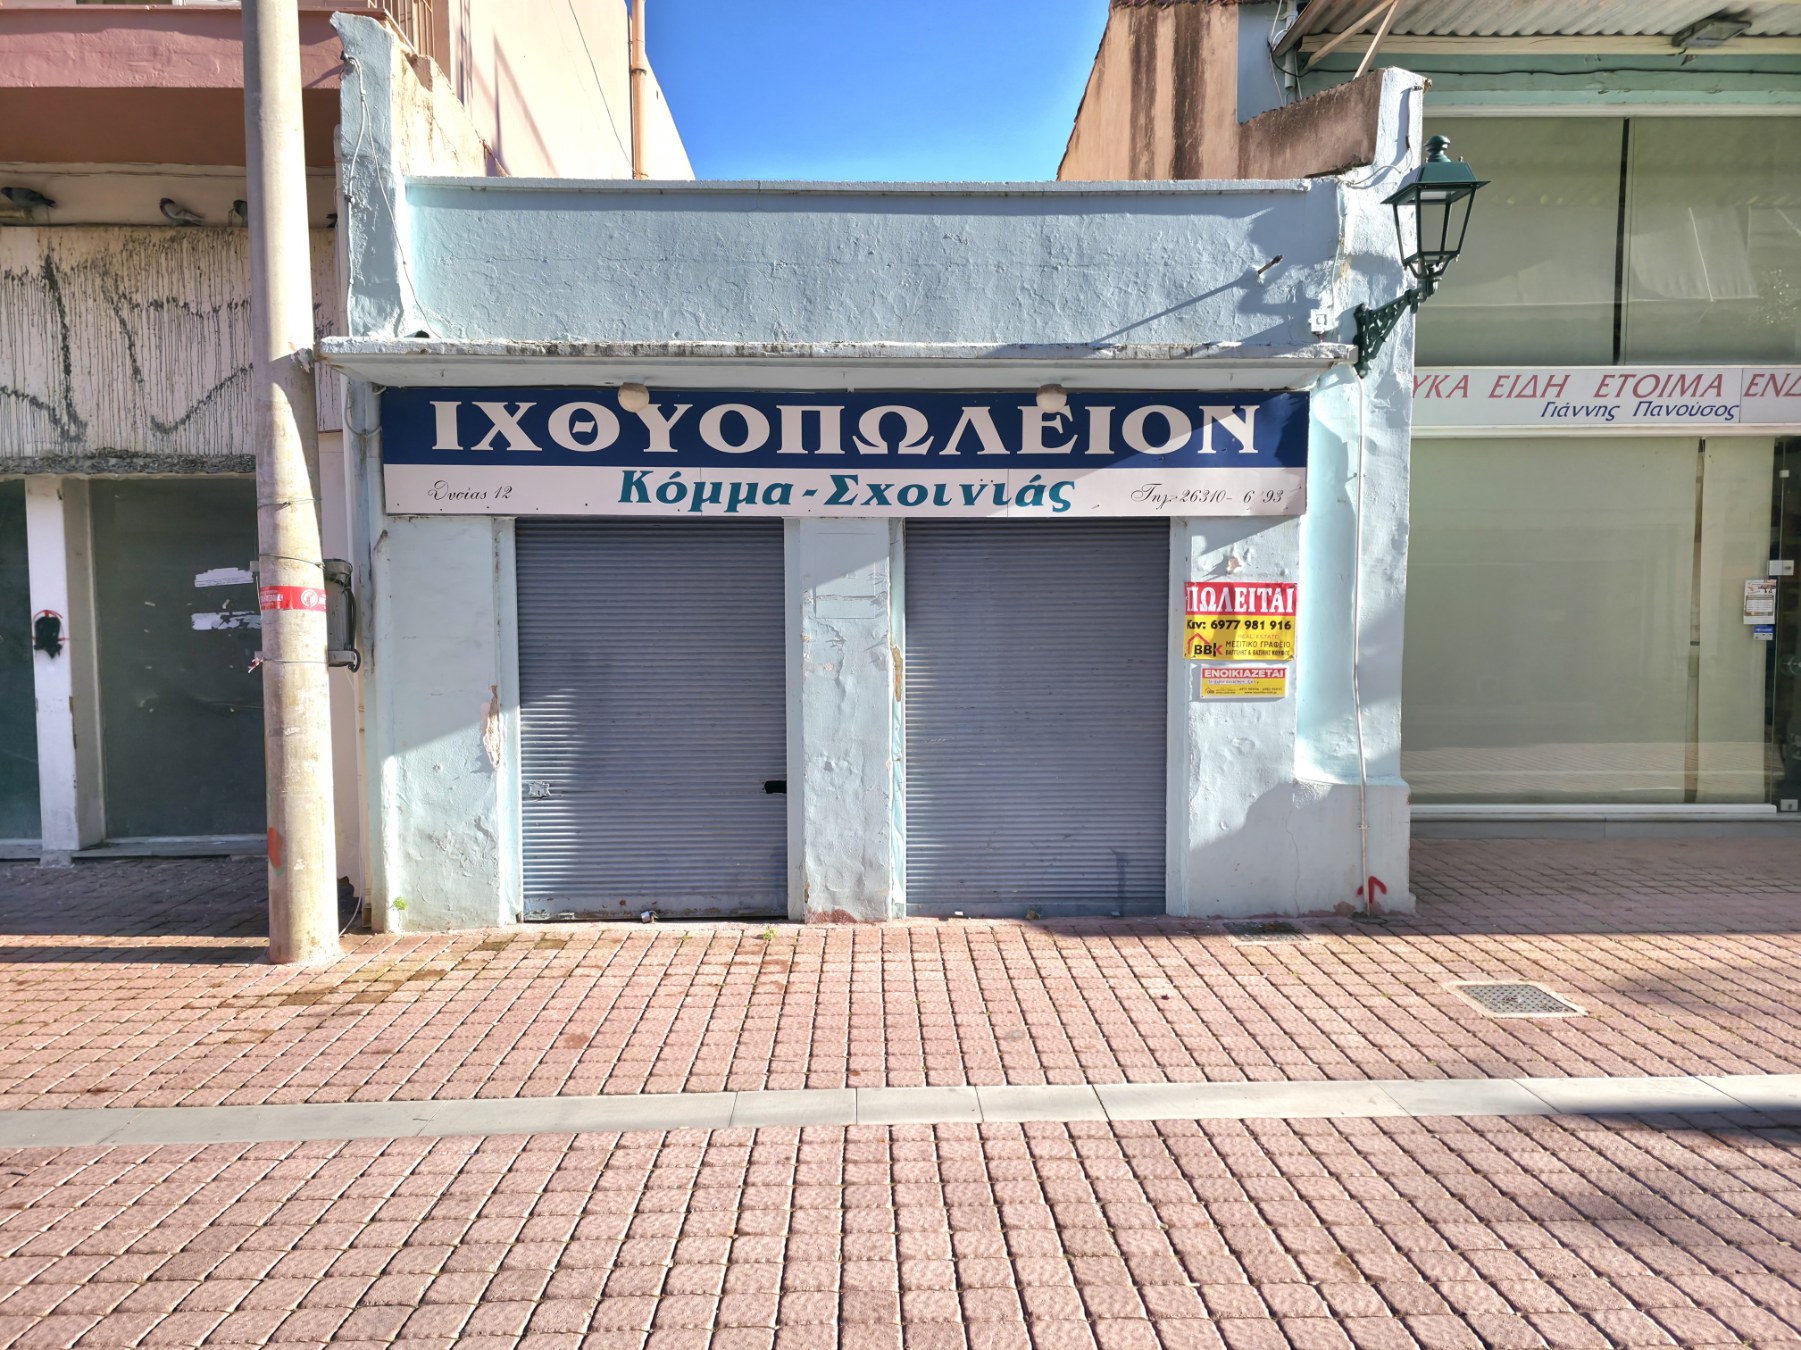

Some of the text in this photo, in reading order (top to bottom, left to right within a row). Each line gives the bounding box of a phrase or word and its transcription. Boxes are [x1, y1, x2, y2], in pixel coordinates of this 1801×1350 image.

[1487, 374, 1572, 399] ΕΙΔΗ
[1592, 374, 1723, 399] ΕΤΟΙΜΑ
[1540, 400, 1740, 422] Γιάννης Πανούσος
[429, 401, 1261, 455] ΙΧΘΥΟΠΩΛΕΙΟΝ
[494, 485, 513, 499] 12
[1186, 586, 1295, 613] ΠΩΛΕΙΤΑΙ
[1210, 619, 1242, 631] 6977
[1244, 620, 1266, 631] 981
[1269, 620, 1292, 631] 916
[1260, 641, 1291, 649] ΓΡΑΦΕΙΟ
[1204, 669, 1284, 678] ΕΝΟΙΚΙΑΖΕΤΑΙ
